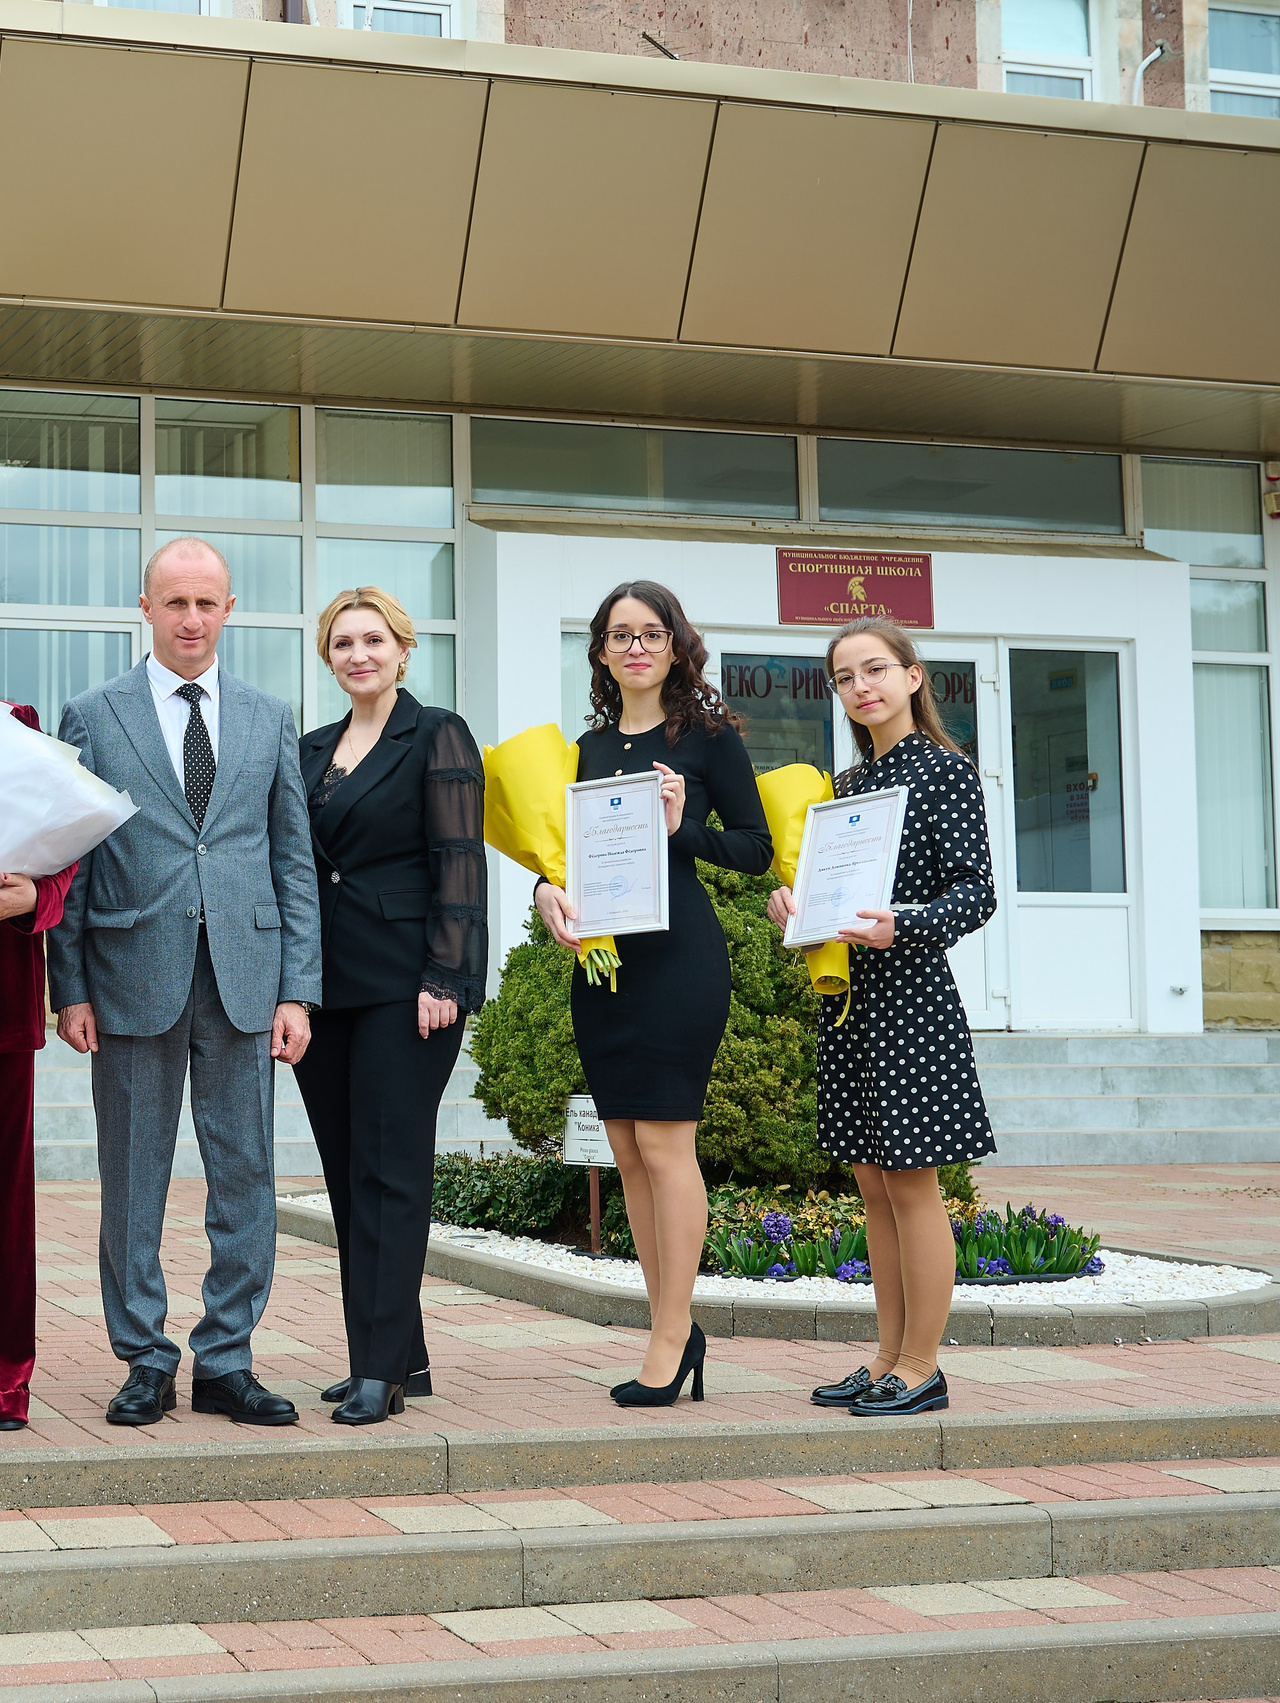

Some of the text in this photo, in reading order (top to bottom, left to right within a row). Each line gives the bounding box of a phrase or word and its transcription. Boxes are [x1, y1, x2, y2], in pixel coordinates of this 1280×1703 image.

[782, 551, 837, 560] МУНИЦИПАЛЬНОЕ
[839, 554, 879, 562] БЮДЖЕТНОЕ
[788, 562, 922, 577] СПОРТИВНАЯ ШКОЛА
[824, 602, 892, 615] «СПАРТА»
[583, 822, 649, 839] Благодарность
[565, 1107, 578, 1118] Ель
